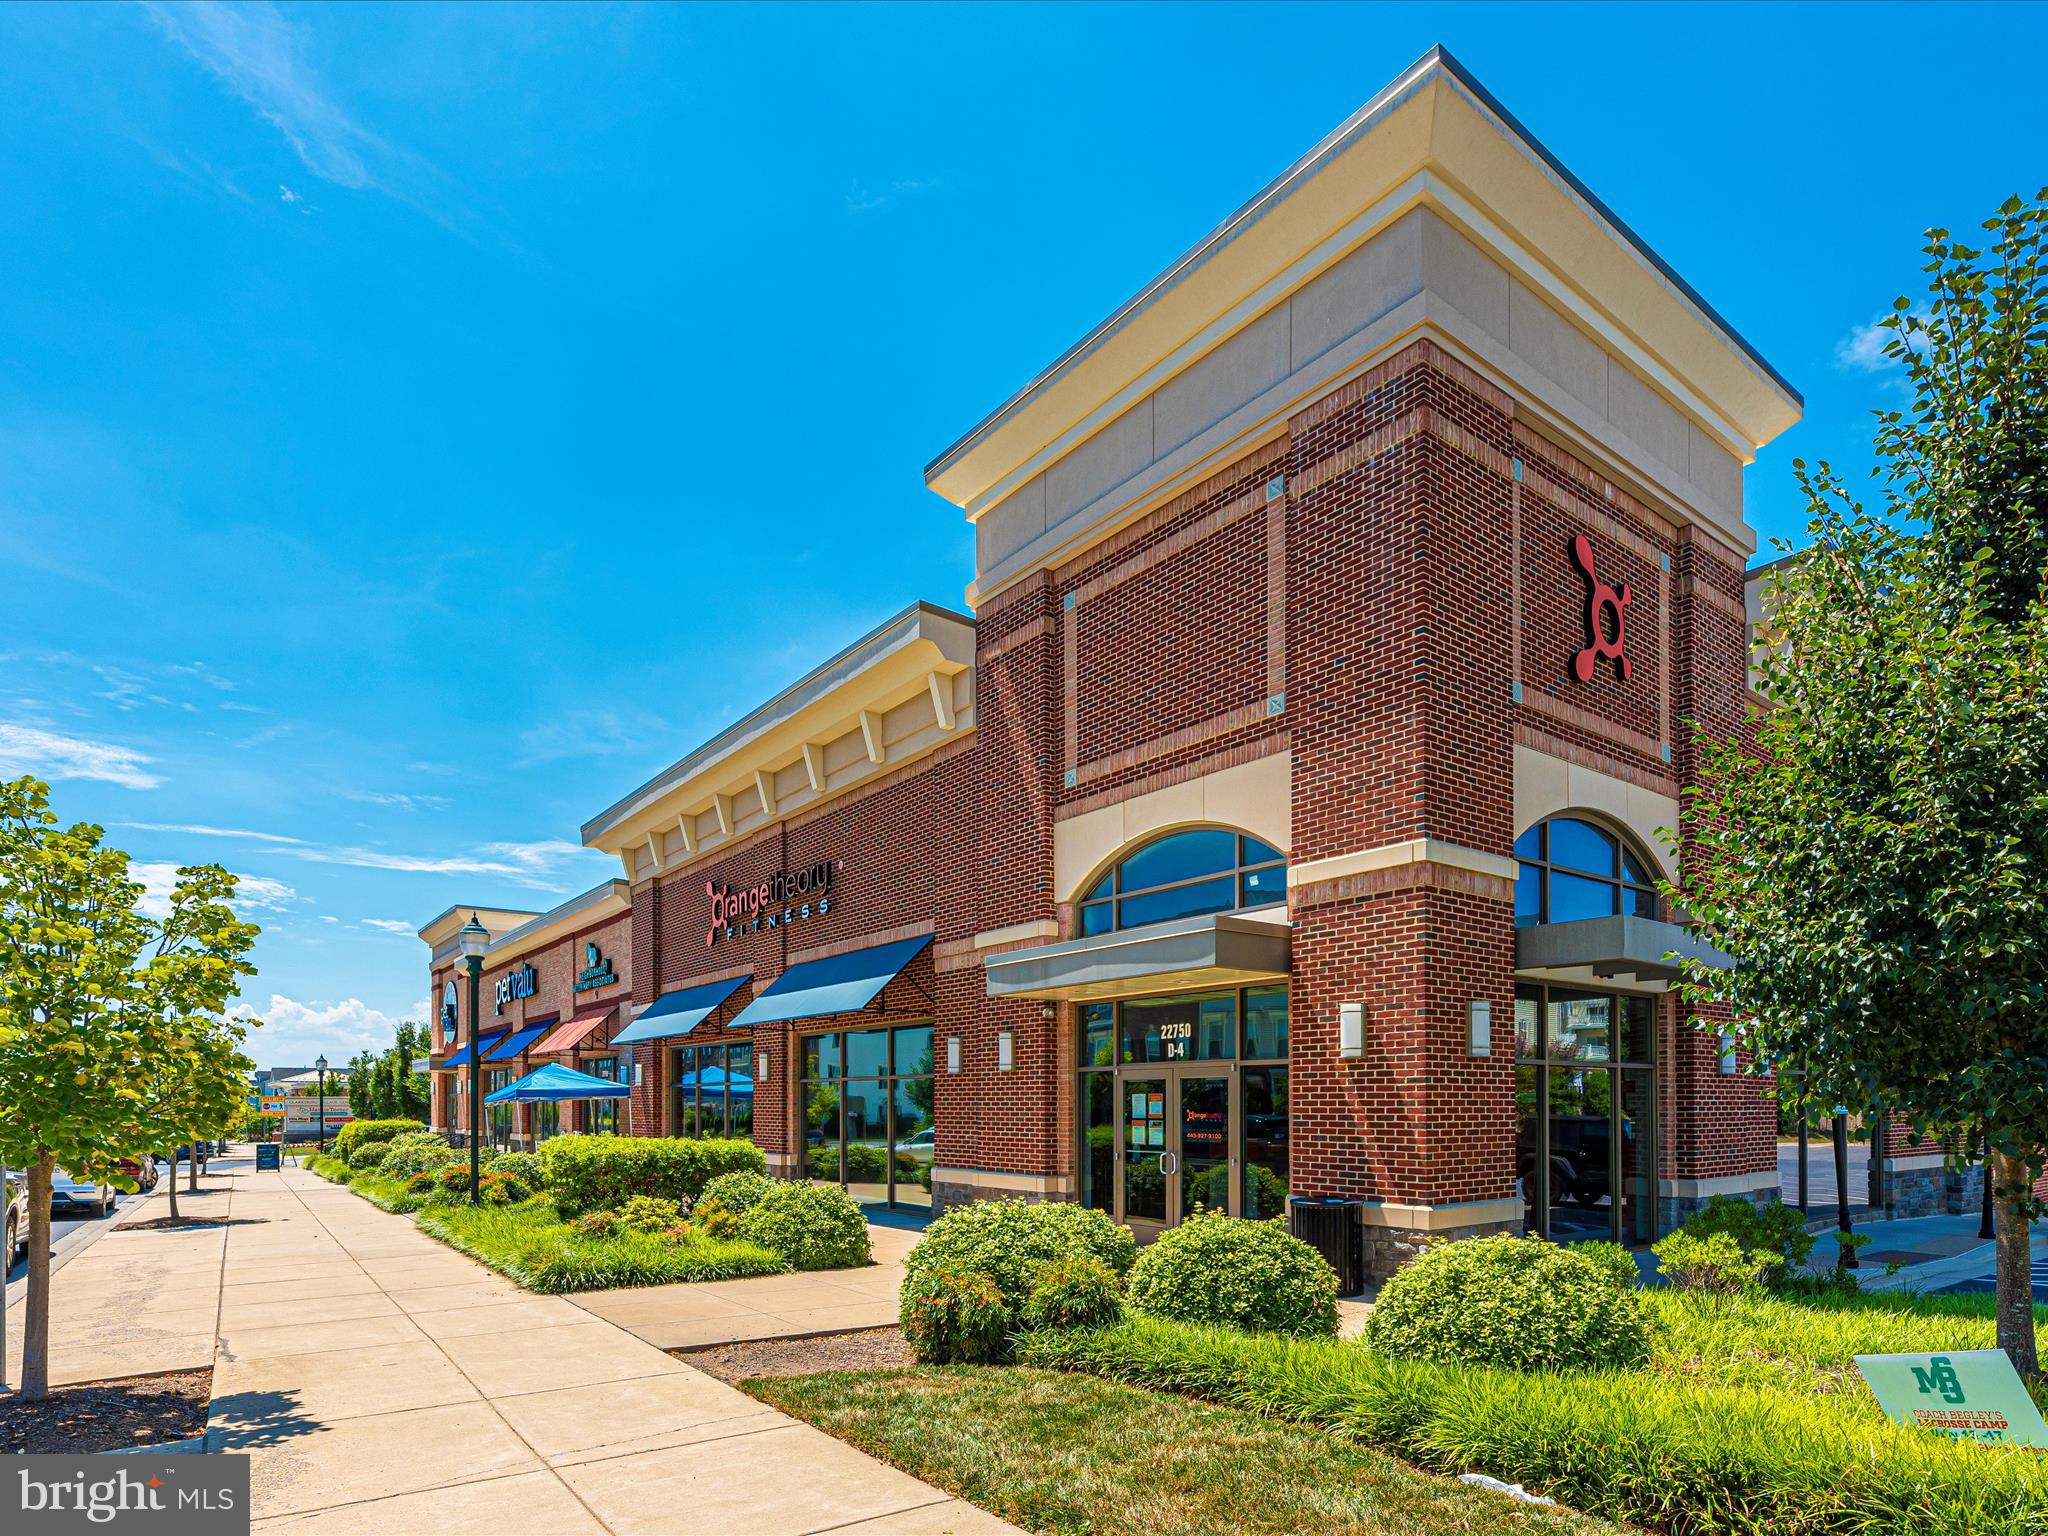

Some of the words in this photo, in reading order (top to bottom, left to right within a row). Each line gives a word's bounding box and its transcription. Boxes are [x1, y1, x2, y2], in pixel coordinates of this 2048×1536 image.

[726, 898, 829, 941] FITNESS
[1160, 1022, 1191, 1039] 22750
[1167, 1042, 1184, 1057] D-4
[1913, 1409, 1947, 1420] COACH
[1949, 1410, 2004, 1420] BEGLEY'S
[1973, 1420, 2009, 1430] CAMP
